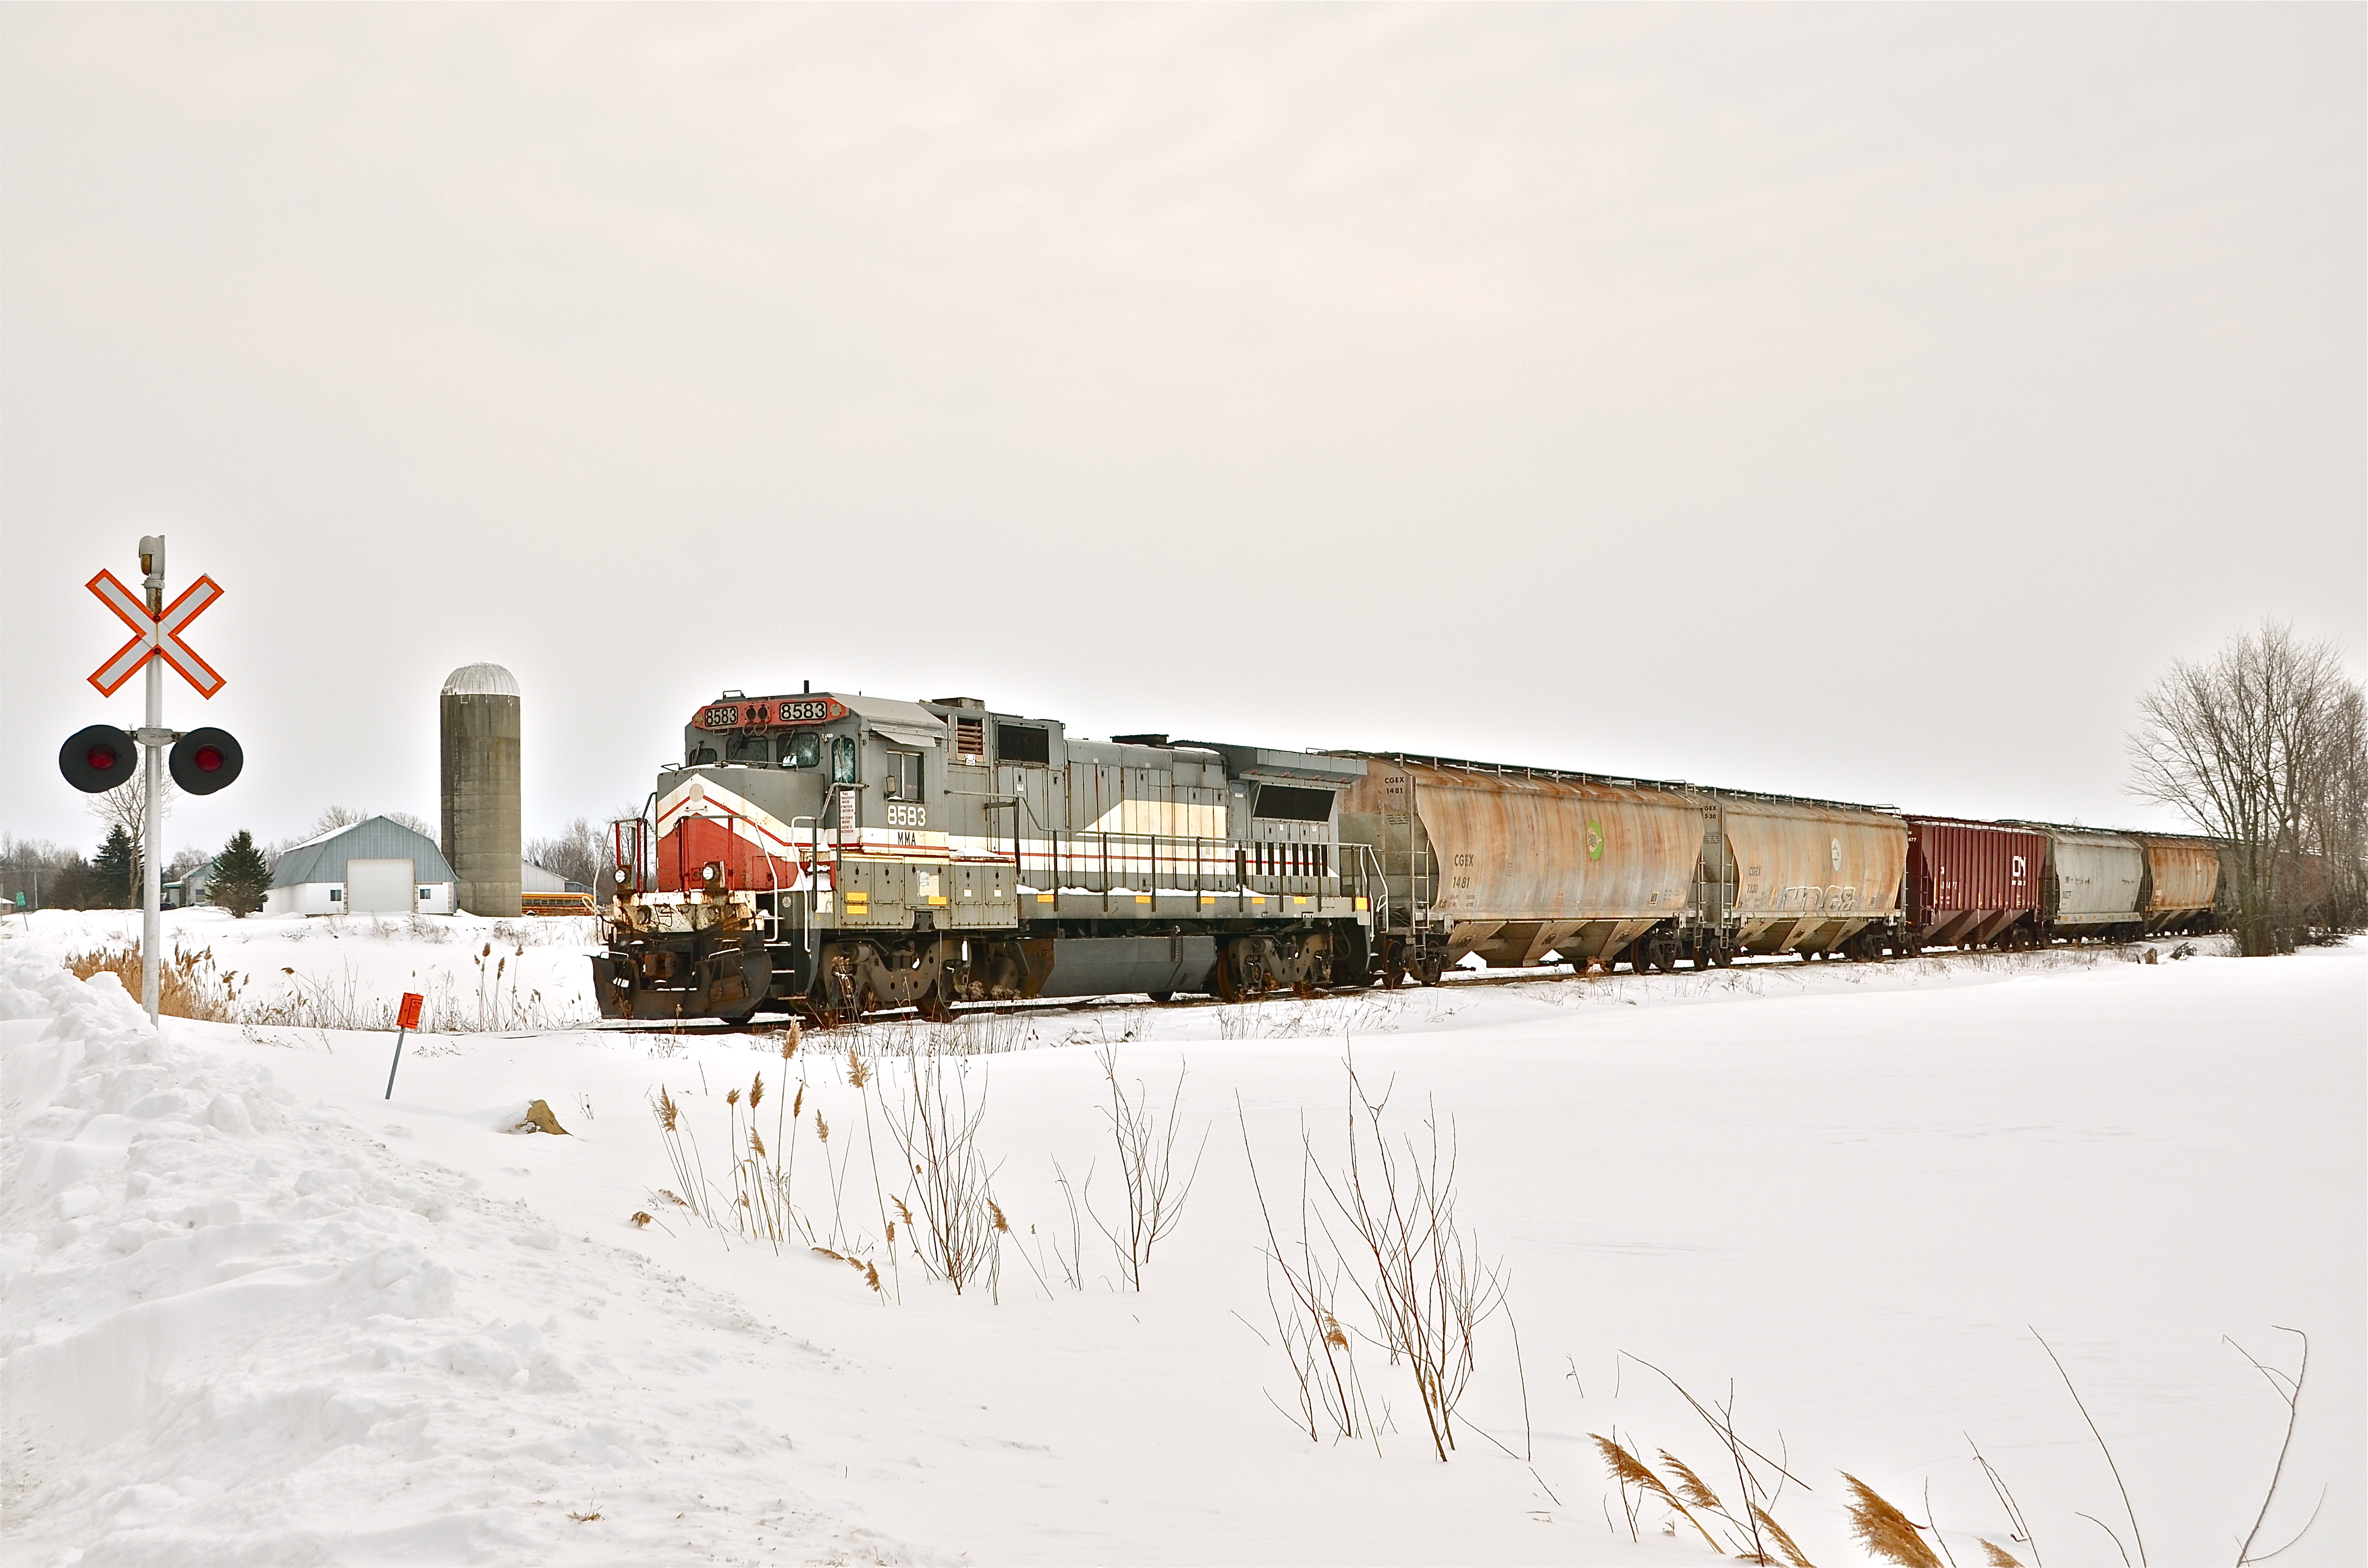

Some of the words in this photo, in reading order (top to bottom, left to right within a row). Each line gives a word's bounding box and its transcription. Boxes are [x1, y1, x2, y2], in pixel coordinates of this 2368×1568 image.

[706, 707, 737, 725] 8583
[781, 703, 825, 719] 8583
[887, 805, 926, 827] 8583
[898, 831, 916, 846] MMA
[1454, 854, 1473, 866] CGEX
[2013, 856, 2026, 877] CN
[1749, 866, 1761, 876] CGEX
[1453, 876, 1470, 889] 1481
